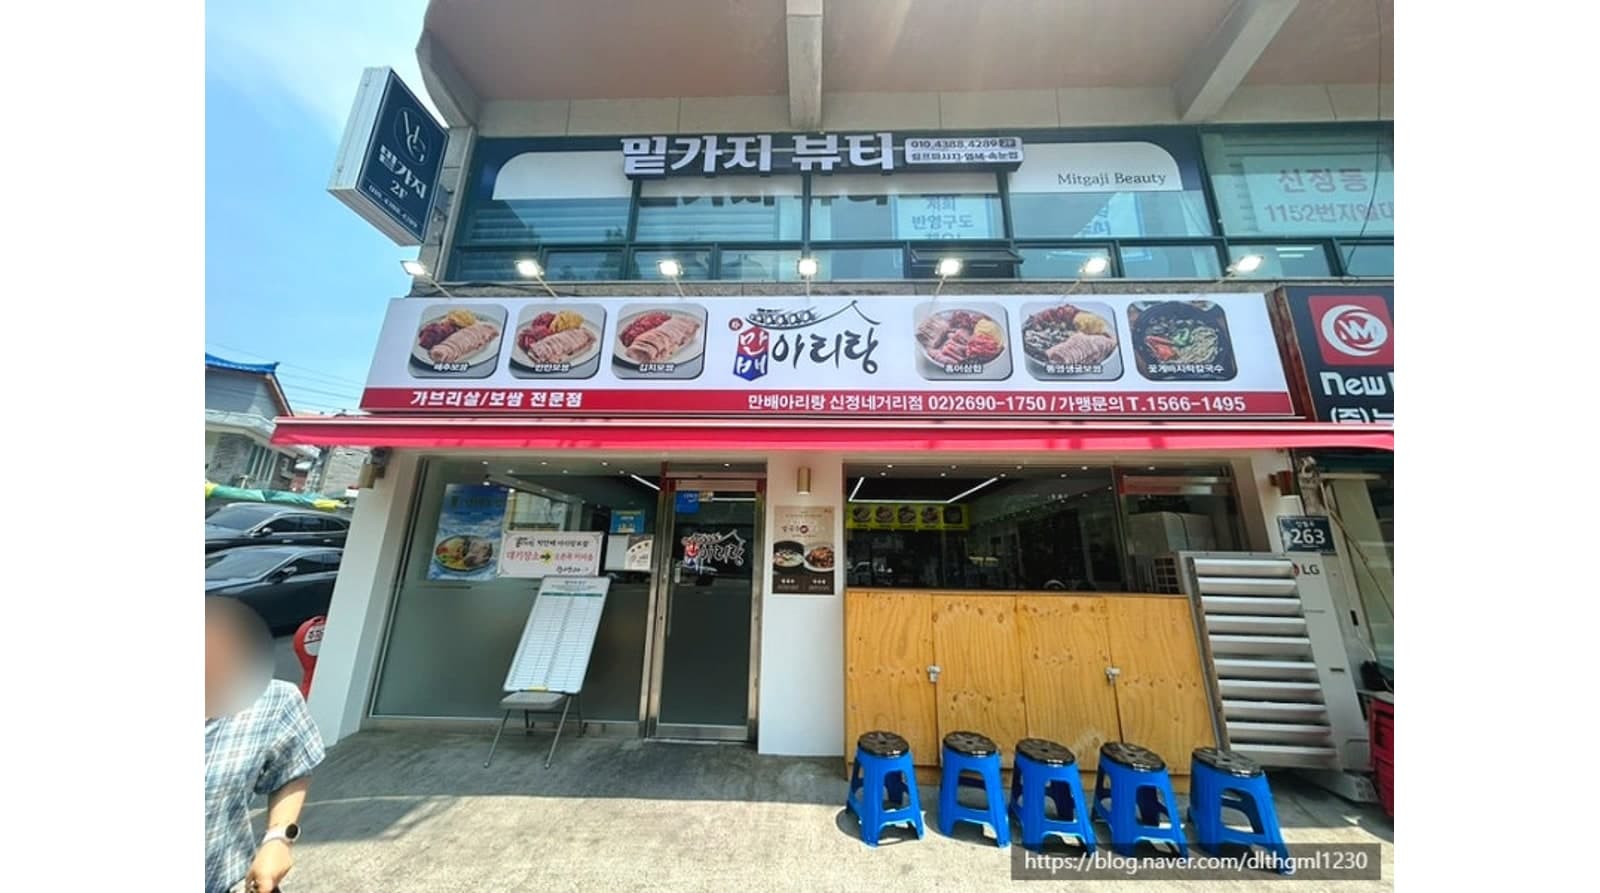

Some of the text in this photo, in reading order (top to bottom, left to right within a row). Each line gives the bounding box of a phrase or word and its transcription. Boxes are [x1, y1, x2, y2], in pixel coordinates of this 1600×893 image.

[620, 132, 895, 174] 밑가지 뷰티
[1057, 171, 1167, 188] Mitgaji Beauty
[772, 327, 880, 375] 아리랑
[410, 390, 584, 408] 가브리살/보쌈 전문점
[748, 394, 826, 410] 만배아리랑
[830, 394, 923, 410] 신정네거리점
[928, 395, 1047, 411] 02)2690-1750
[1290, 528, 1326, 545] 263
[1301, 564, 1321, 576] LG
